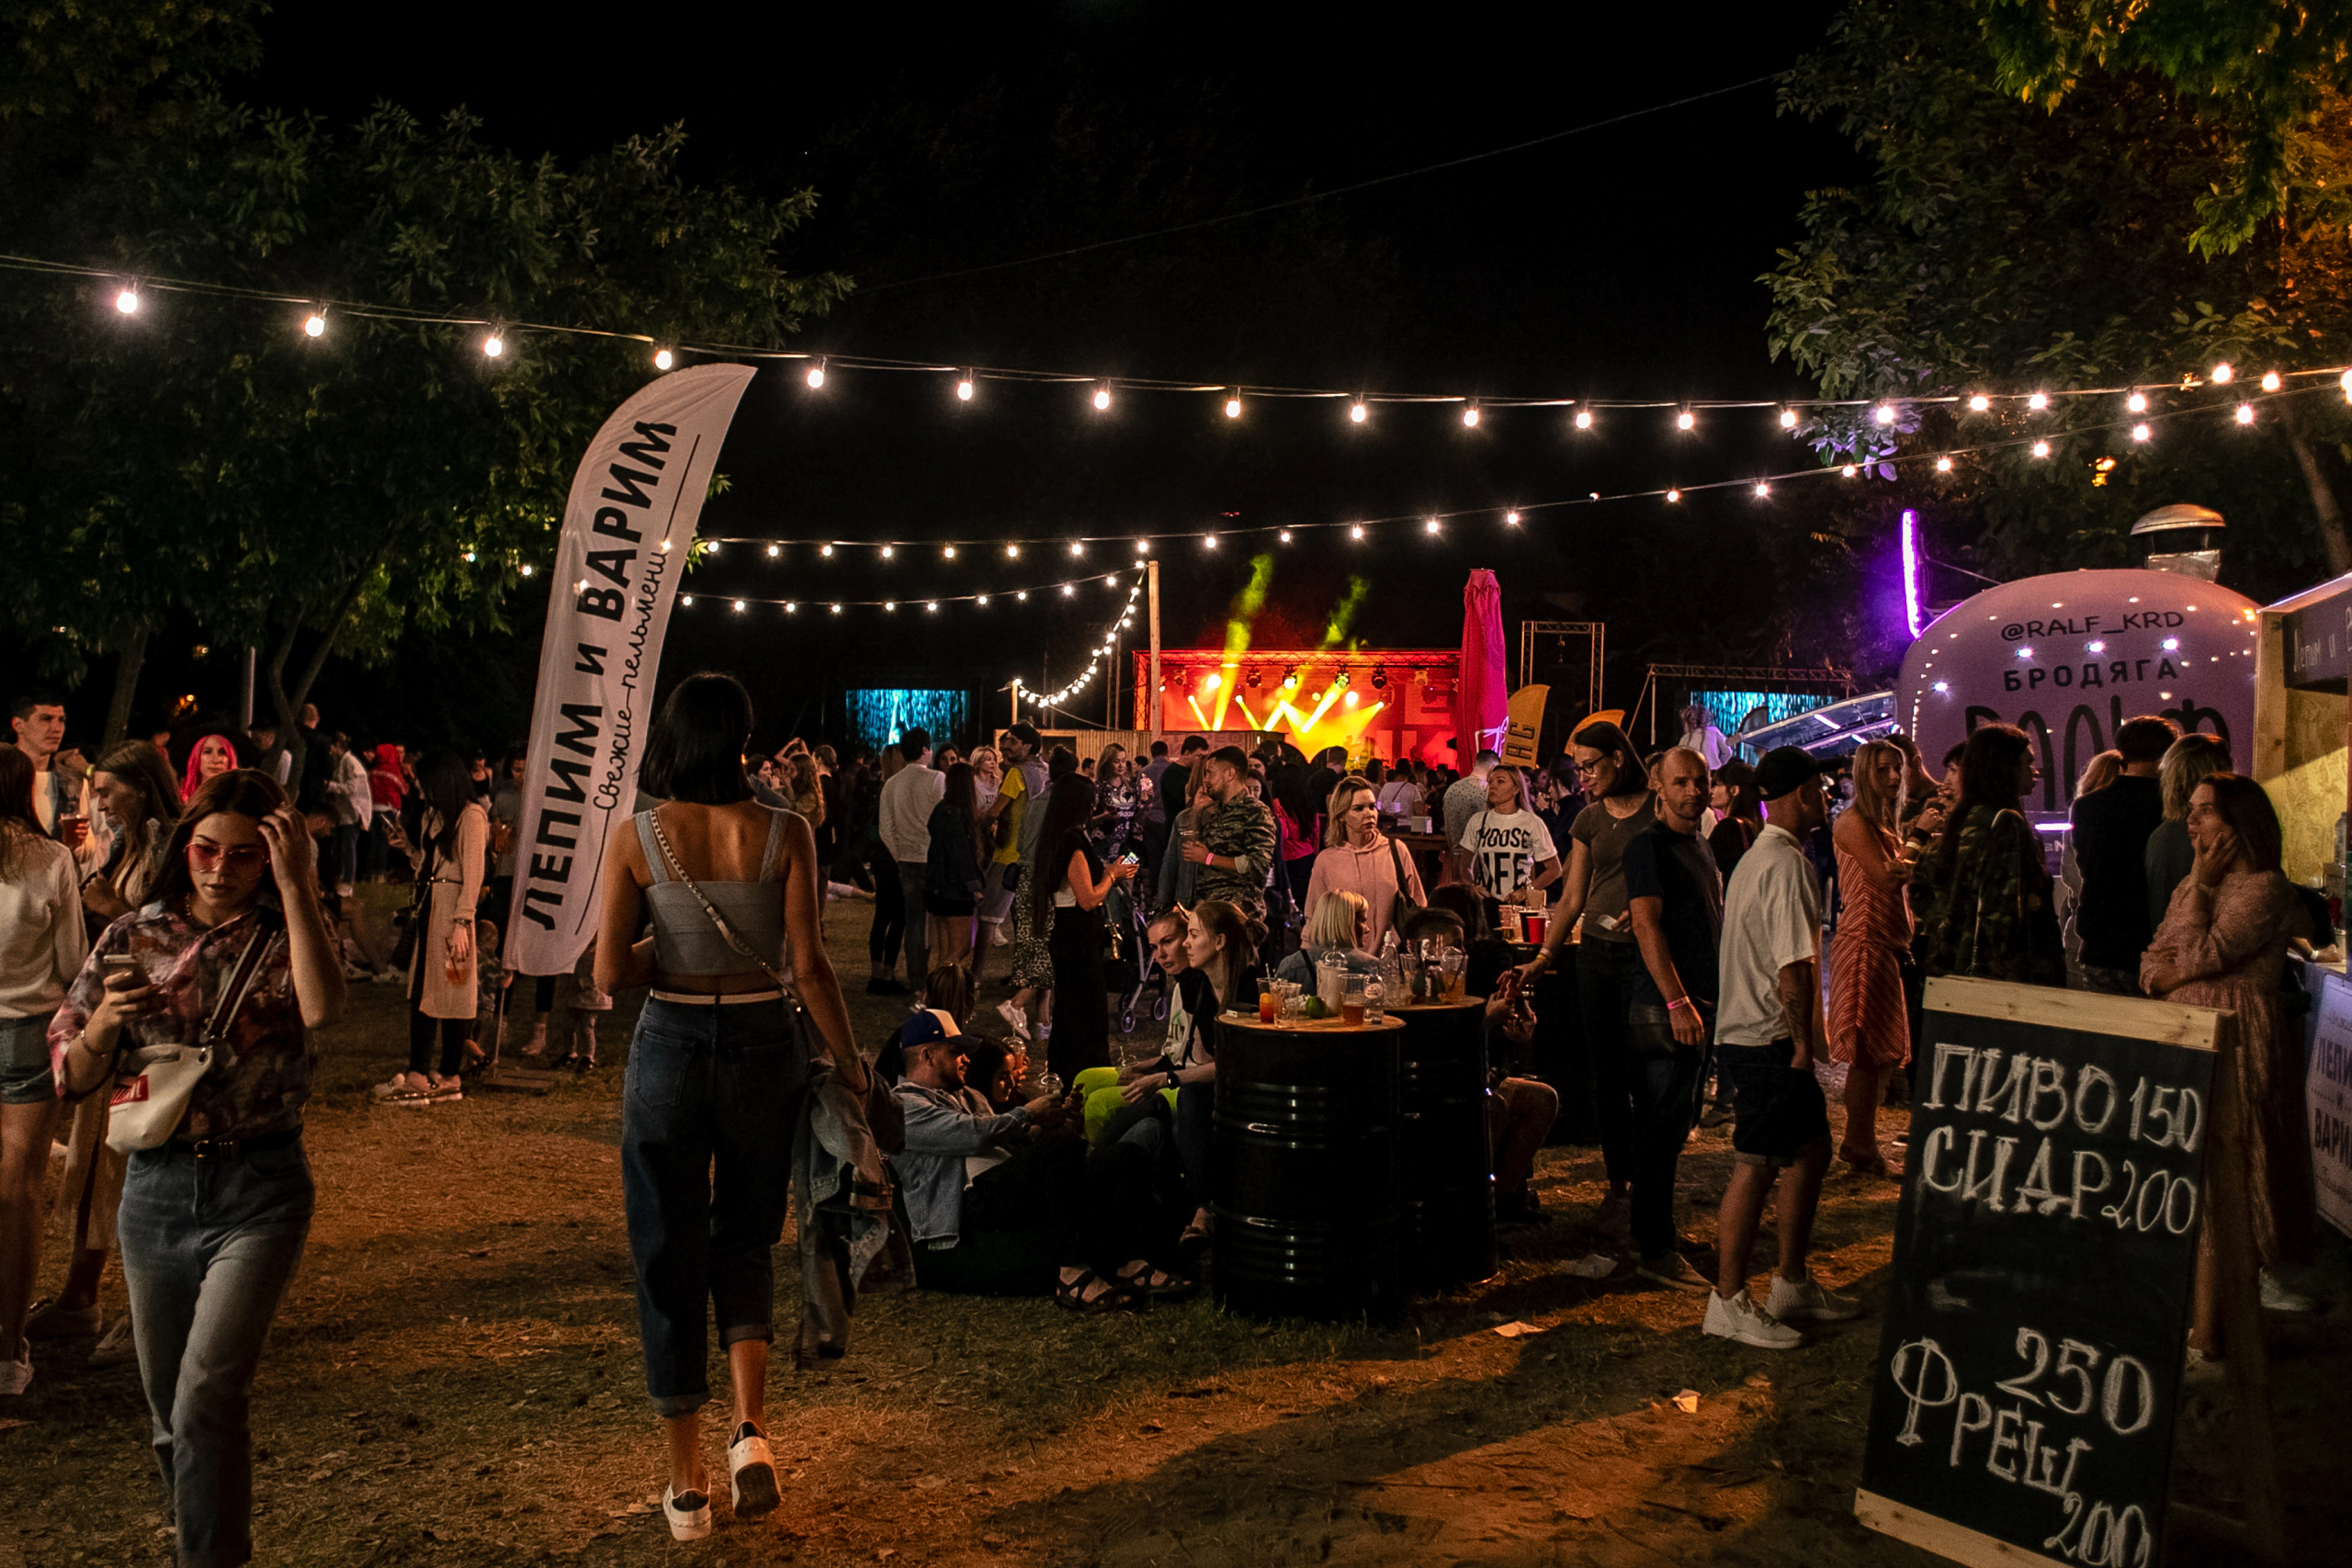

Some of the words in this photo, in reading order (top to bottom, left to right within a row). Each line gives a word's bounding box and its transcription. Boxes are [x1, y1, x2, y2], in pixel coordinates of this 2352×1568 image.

[522, 703, 603, 931] ЛЕПИМ
[576, 421, 677, 622] ВАРИМ
[2000, 610, 2185, 642] @RALF_KRD
[2003, 657, 2178, 692] БРОДЯГА
[593, 707, 632, 810] Свежие
[621, 551, 669, 689] пельмени
[1923, 1043, 2116, 1134] ПИВО
[2129, 1077, 2204, 1153] 150
[2314, 1108, 2352, 1171] ВАРИ
[1922, 1125, 2112, 1220] СИДР
[2100, 1160, 2199, 1235] 200
[1995, 1327, 2154, 1435] 250
[2043, 1491, 2152, 1568] 200
